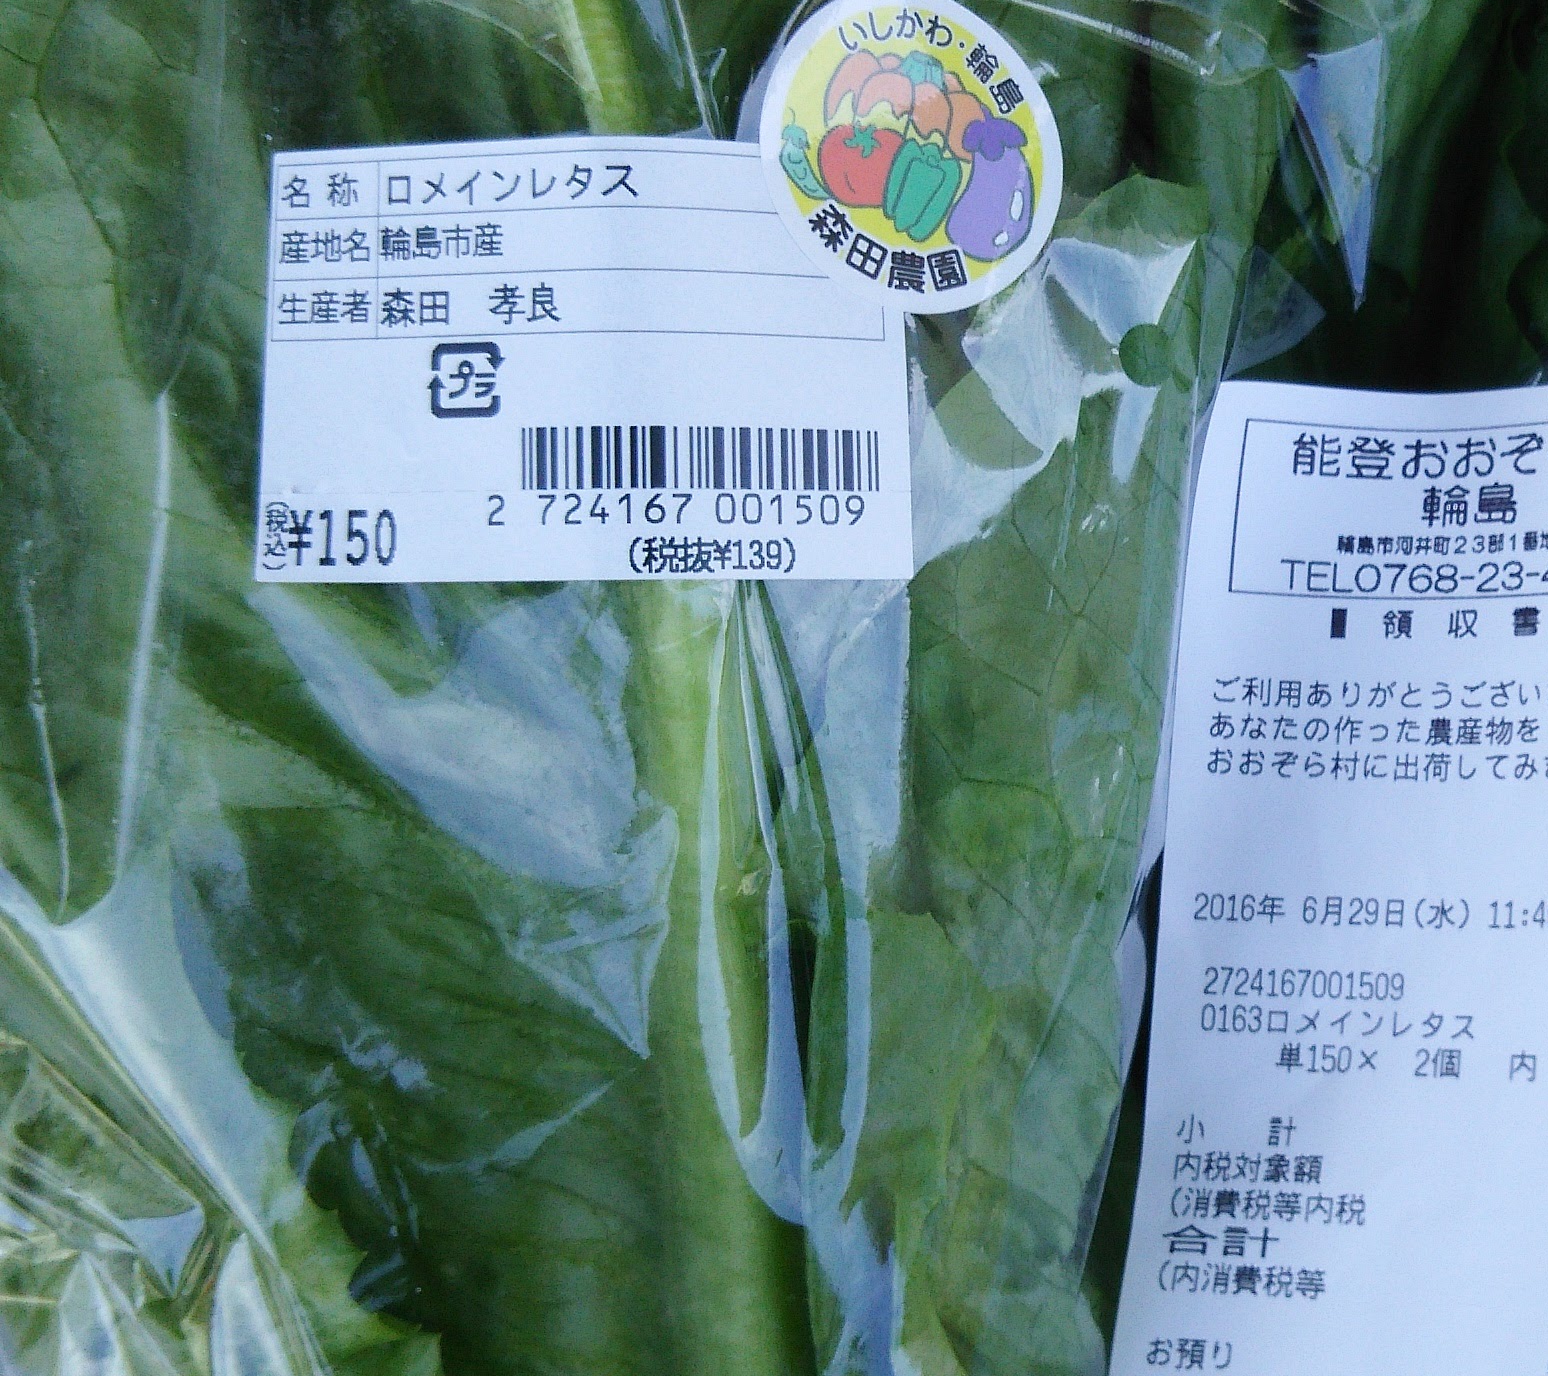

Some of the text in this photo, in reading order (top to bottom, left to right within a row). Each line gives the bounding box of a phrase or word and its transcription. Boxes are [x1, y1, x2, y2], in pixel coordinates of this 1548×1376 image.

[282, 164, 639, 209] 名称 ロメインレタス
[279, 223, 503, 264] 産地名 輪島市産
[809, 203, 968, 294] 森田農園
[279, 282, 562, 327] 生産者 森田 孝良
[487, 492, 866, 526] 2 724167 001509
[1422, 483, 1517, 527] 輪島
[288, 509, 397, 566] ¥150
[1210, 711, 1540, 746] あなたの作った農産物を
[1193, 892, 1285, 923] 2016年
[1203, 967, 1405, 1000] 2724167001509
[1201, 1004, 1474, 1040] 0163ロメインレタス
[1414, 1049, 1462, 1078] 2個
[1510, 1052, 1537, 1081] 内
[1174, 1150, 1323, 1184] 内税対象額
[1162, 1224, 1280, 1258] 合計
[1146, 1336, 1231, 1370] お預り
